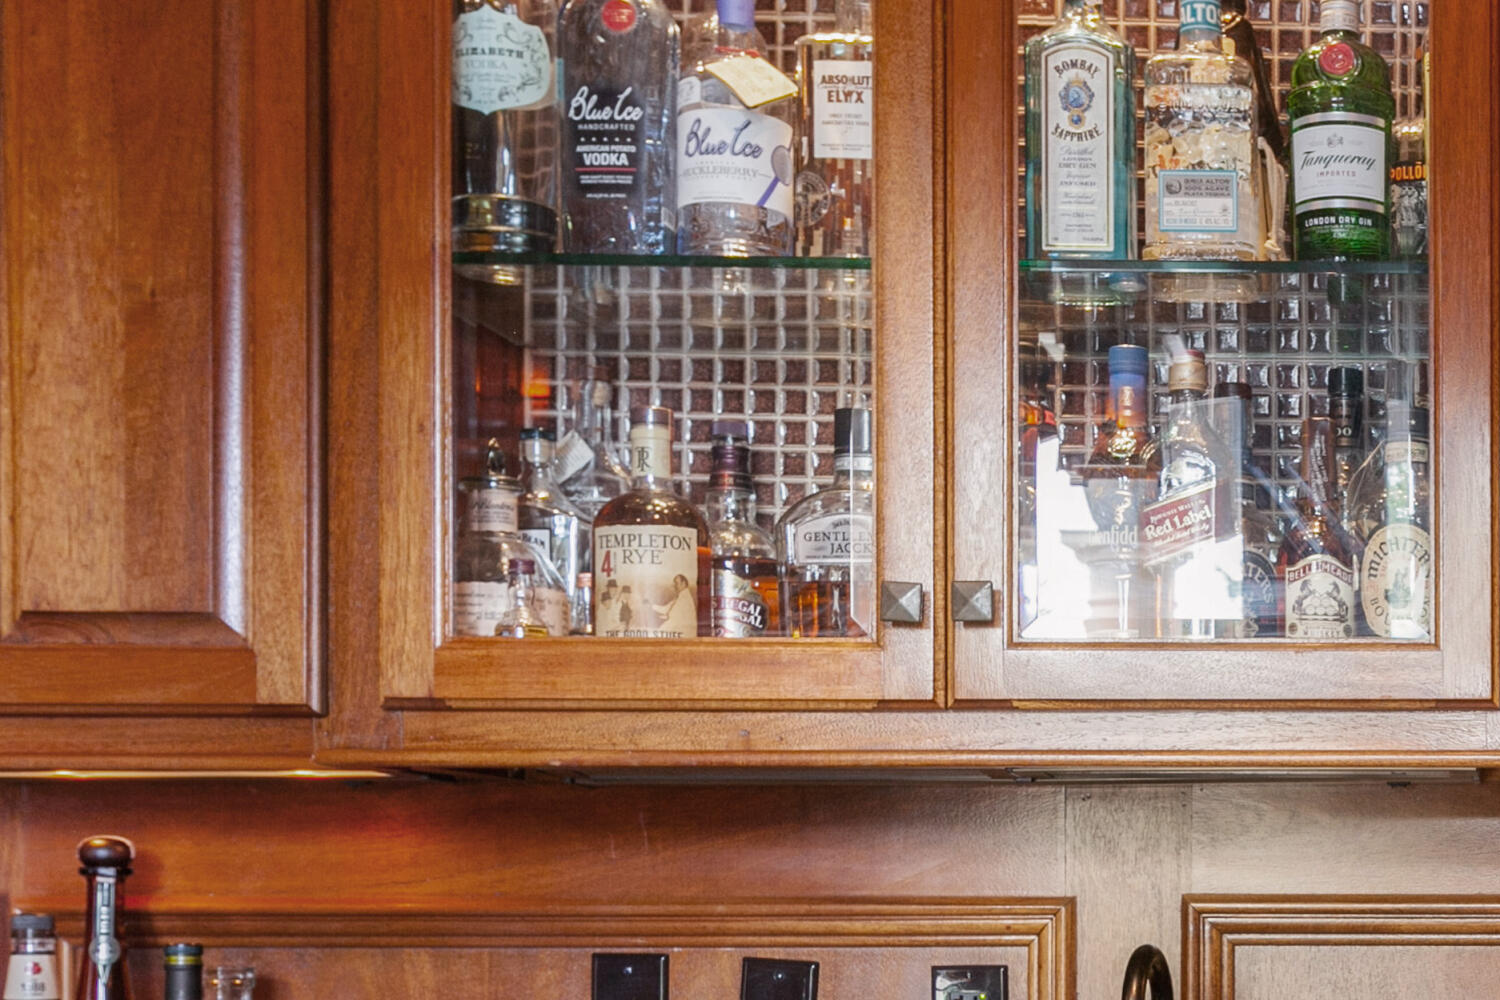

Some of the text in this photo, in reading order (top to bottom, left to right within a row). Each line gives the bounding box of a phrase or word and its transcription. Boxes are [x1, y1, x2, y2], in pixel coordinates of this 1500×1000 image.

[1180, 2, 1223, 25] ALTO
[1053, 58, 1101, 79] BOMBAY
[567, 85, 645, 121] Blue Ice
[577, 123, 636, 131] HANDCRAFTED
[1051, 122, 1105, 142] SAPPHIRE
[684, 117, 764, 159] Blue Ice
[582, 153, 630, 167] VODKA
[1300, 150, 1377, 171] Tanqueray
[1304, 216, 1373, 228] LONDON DRY GIN
[1144, 503, 1212, 541] Red Label
[599, 533, 692, 551] TEMPLETON
[601, 549, 614, 578] 4
[622, 549, 664, 565] RYE
